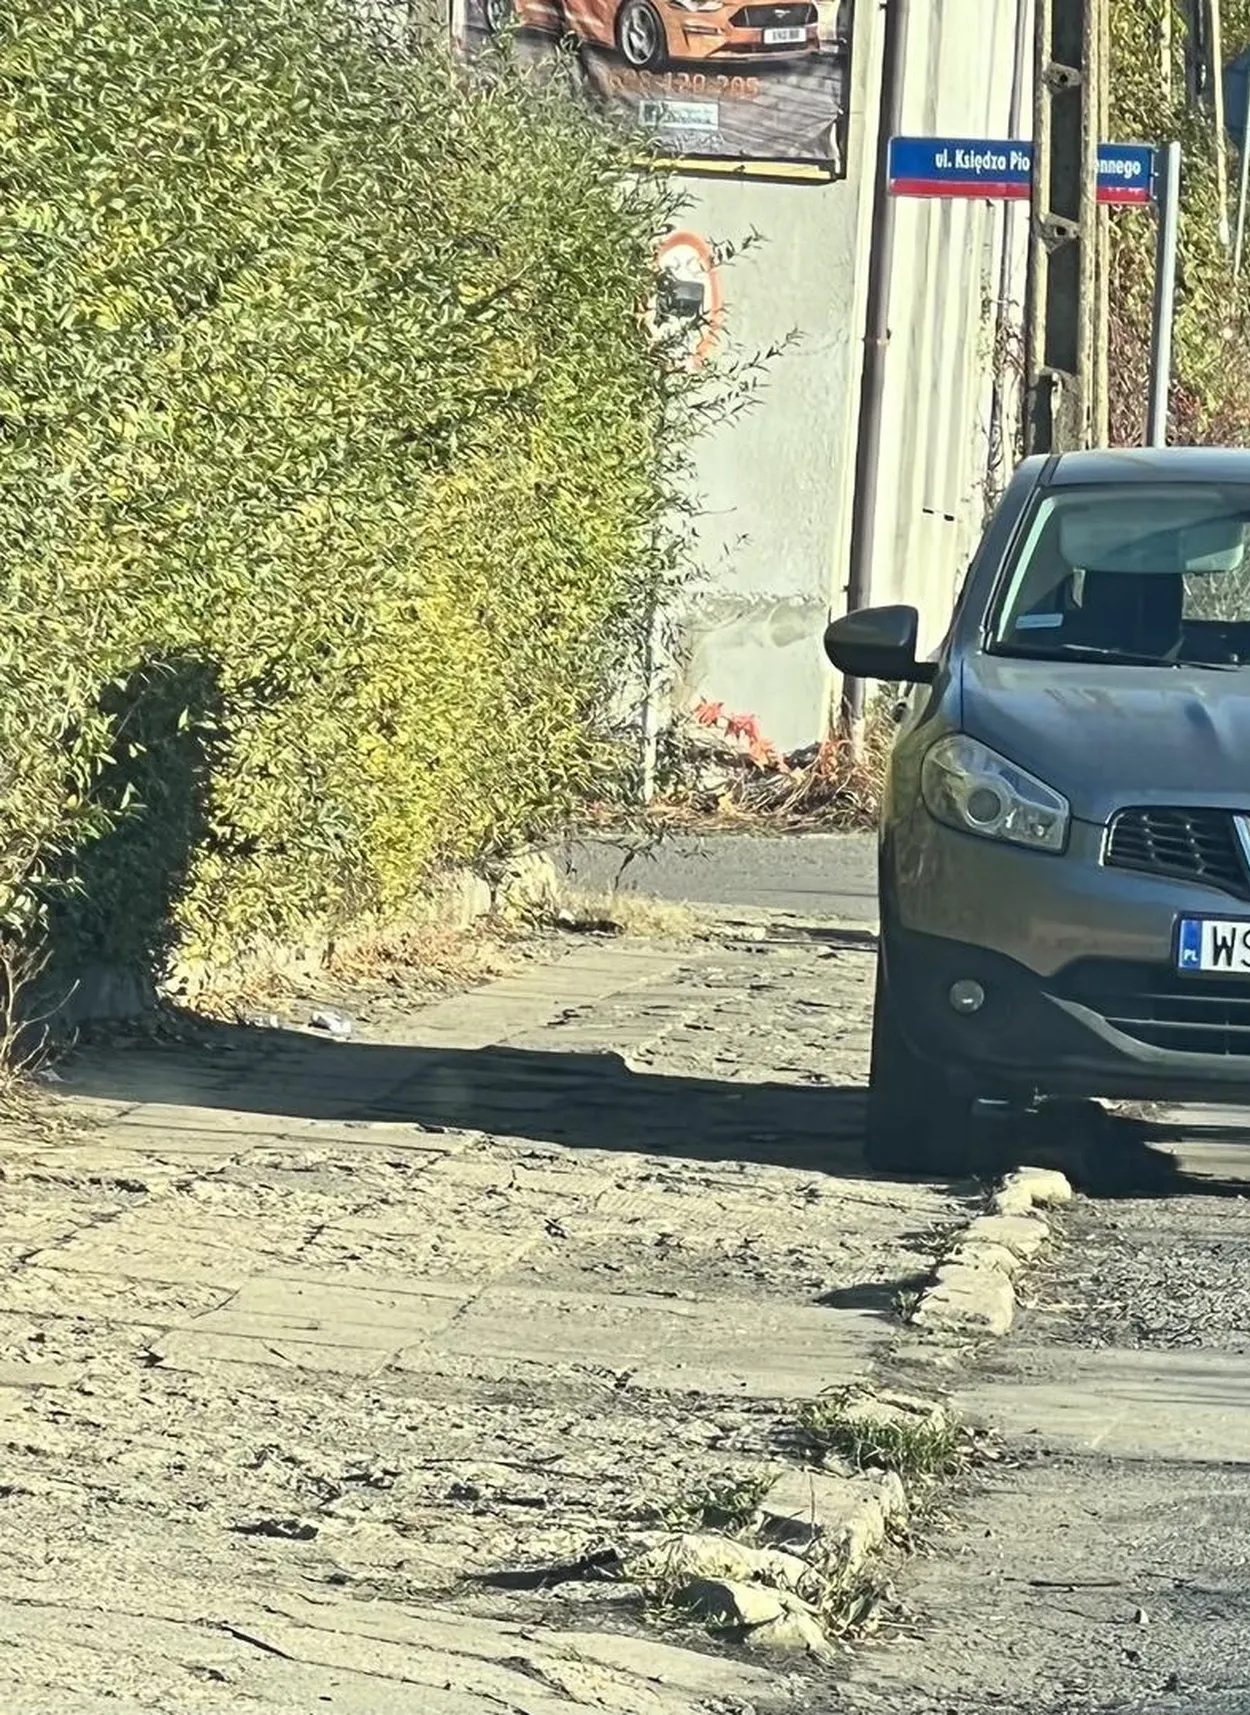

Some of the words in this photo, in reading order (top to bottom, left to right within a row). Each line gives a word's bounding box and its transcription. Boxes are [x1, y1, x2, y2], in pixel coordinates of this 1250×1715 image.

[935, 148, 952, 169] ul.
[955, 149, 1006, 174] Księdza
[1010, 150, 1031, 170] Pio
[1184, 951, 1198, 962] PL
